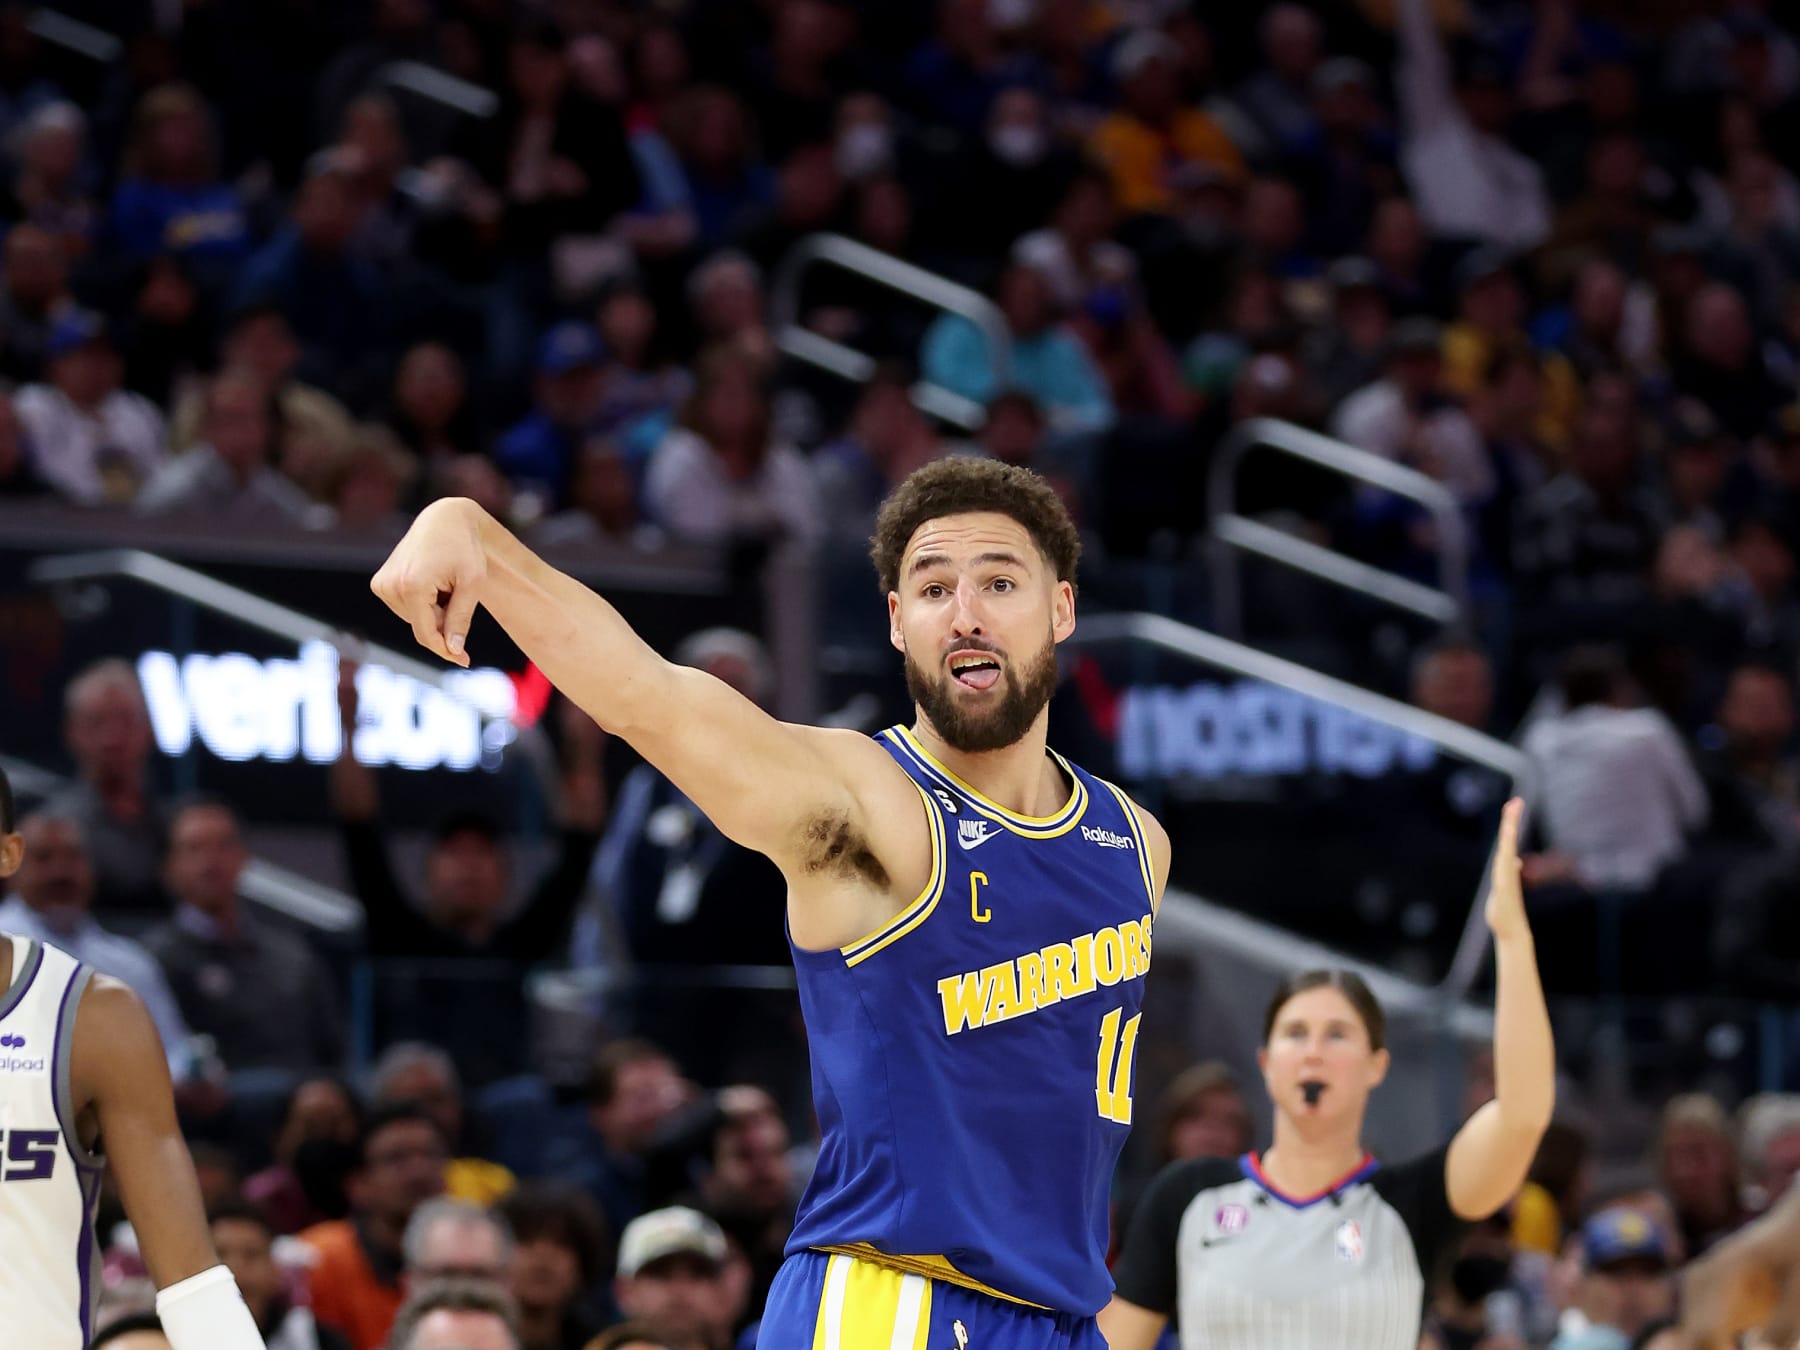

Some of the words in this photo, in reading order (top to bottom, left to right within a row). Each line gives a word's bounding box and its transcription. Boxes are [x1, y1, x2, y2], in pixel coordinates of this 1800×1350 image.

[958, 819, 988, 840] NIKE
[1080, 825, 1136, 850] Rakuten
[969, 871, 992, 924] C
[937, 913, 1154, 1037] WARRIORS
[1095, 1006, 1144, 1126] 11
